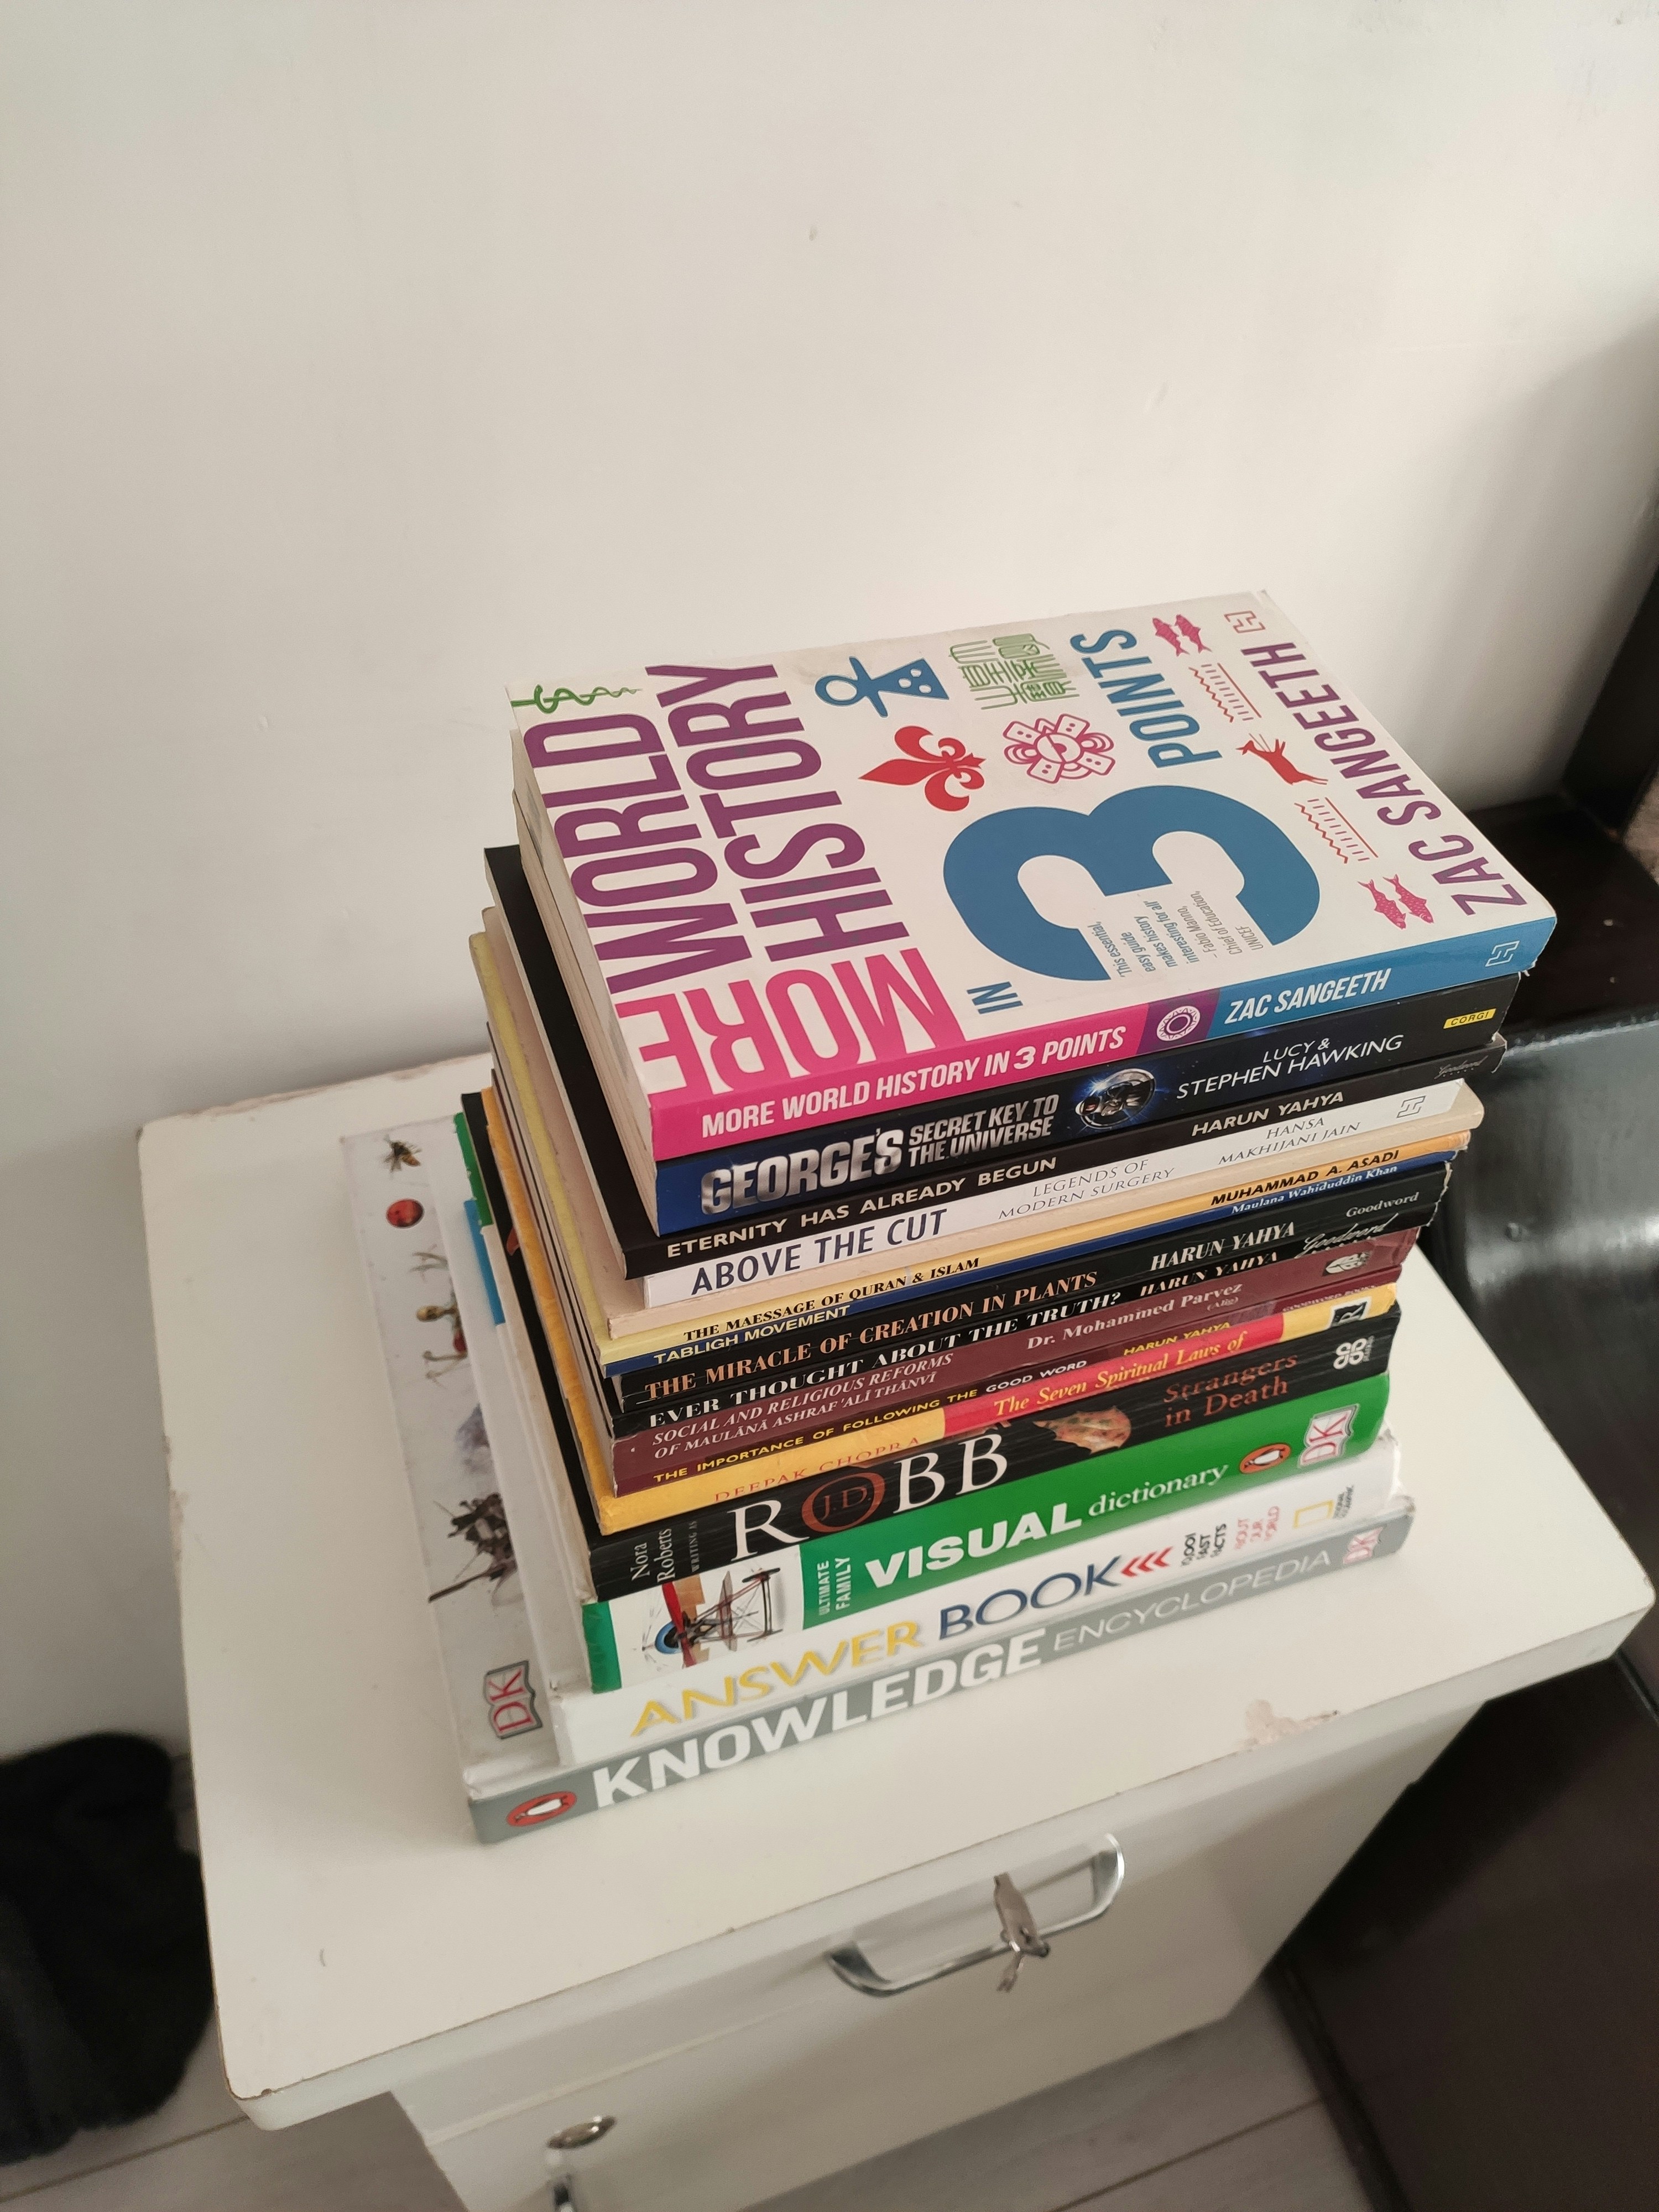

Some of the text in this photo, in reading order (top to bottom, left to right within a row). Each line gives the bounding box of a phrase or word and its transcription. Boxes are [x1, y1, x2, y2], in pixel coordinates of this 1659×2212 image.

[1069, 629, 1223, 768] POINTS
[1241, 642, 1528, 916] ZAC SANGEETH
[645, 664, 910, 962] HISTORY
[523, 713, 752, 994] WORLD
[943, 785, 1320, 982] 3
[1134, 916, 1178, 967] makes history
[1155, 912, 1170, 922] for
[1164, 922, 1199, 964] interesting
[1177, 905, 1202, 932] Manno,
[1191, 891, 1243, 955] Chief of Education,
[1196, 932, 1217, 953] Fabio
[1235, 926, 1264, 951] UNICEF
[1120, 931, 1156, 972] easy guide
[617, 948, 967, 1095] MORE
[966, 982, 1022, 1014] IN
[1224, 968, 1392, 1025] ZAC SANGEETH
[1451, 1011, 1489, 1026] CORGI
[1176, 1035, 1404, 1099] STEPHEN HAWKING
[1262, 1038, 1331, 1063] LUCY &
[702, 1026, 1126, 1138] MORE WORLD HISTORY IN 3 POINTS
[907, 1115, 1054, 1168] THE UNIVERSE
[909, 1094, 1060, 1146] SECRET KEY TO
[1191, 1092, 1343, 1137] HARUN YAHYA
[1266, 1117, 1324, 1139] HANSA
[1218, 1122, 1361, 1165] MAKHIJANI JAIN
[701, 1128, 904, 1215] GEORGE'S
[998, 1168, 1175, 1219] MODERN SURGERY
[1032, 1159, 1149, 1197] LEGENDS OF
[1211, 1150, 1399, 1206] MUHAMMAD A. ASADI
[1232, 1165, 1397, 1214] Maulana Wahiduddin Khan
[667, 1157, 1056, 1258] ETERNITY HAS ALREADY BEGUN
[1346, 1192, 1420, 1218] Goodword
[691, 1208, 947, 1295] ABOVE THE CUT
[1140, 1251, 1277, 1296] HARUN YAHYA
[1150, 1238, 1226, 1271] HARUN
[1232, 1222, 1295, 1250] YAHYA
[684, 1258, 979, 1341] THE MAESSAGE OF QURAN & ISLAM
[1027, 1284, 1243, 1350] Dr. Mohammed Parvez
[645, 1271, 1097, 1400] THE MIRACLE OF CREATION IN PLANTS
[650, 1292, 1121, 1427] EVER THOUGHT ABOUT THE TRUTH?
[654, 1305, 850, 1364] TABLIGH MOVEMENT
[1124, 1322, 1231, 1356] HARUN YAHYA
[652, 1353, 953, 1446] SOCIAL AND RELIGIOUS REFORMS
[994, 1331, 1248, 1416] The Seven Spiritual Laws of
[1164, 1355, 1298, 1403] Strangers
[653, 1360, 1087, 1483] THE IMPORTANCE OF FOLLOWING THE GOOD WORD
[1165, 1375, 1288, 1427] in Death
[654, 1442, 681, 1459] OF
[772, 1401, 838, 1428] ASHRAF
[819, 1437, 919, 1470] CHOPRA
[1302, 1412, 1348, 1463] DK
[688, 1532, 700, 1572] WRITING
[865, 1463, 1229, 1588] VISUAL dictionary
[630, 1542, 650, 1581] Nora
[654, 1528, 675, 1583] Roberts
[817, 1560, 830, 1616] ULTIMATE
[834, 1557, 851, 1611] FAMILY
[630, 1556, 1123, 1737] ANSWER BOOK
[488, 1668, 533, 1733] DK
[592, 1550, 1332, 1808] KNOWLEDGE ENCYCLOPEDIA
